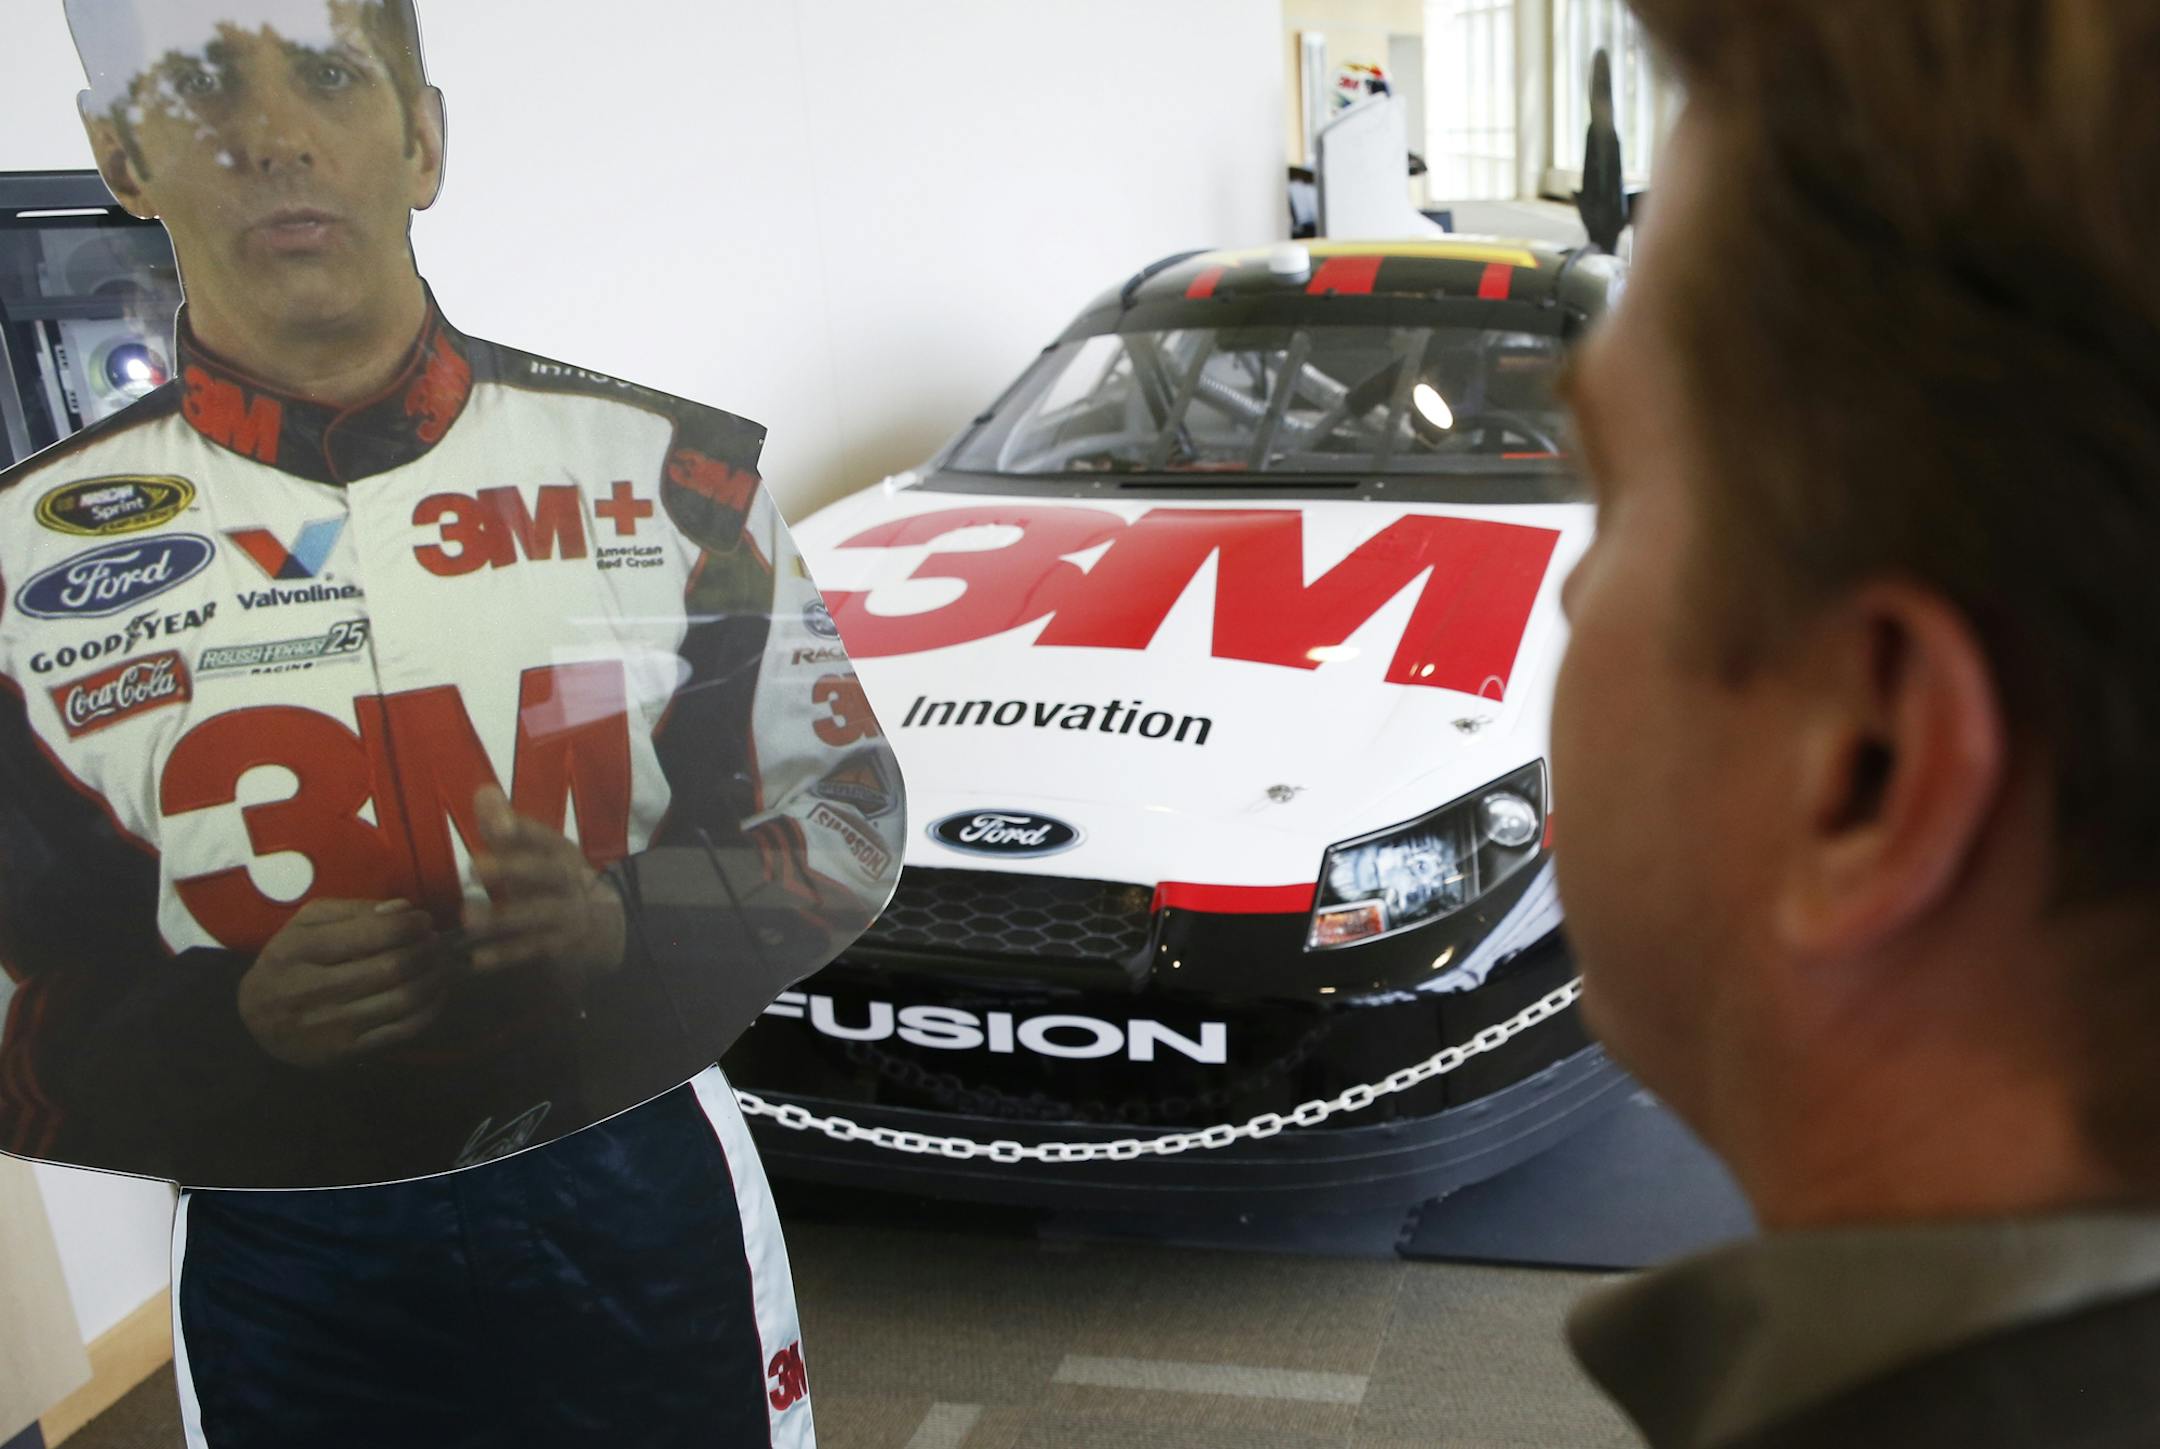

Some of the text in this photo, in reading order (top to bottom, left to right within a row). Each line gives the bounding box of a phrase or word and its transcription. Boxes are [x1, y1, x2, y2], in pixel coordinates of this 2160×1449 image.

[183, 366, 282, 464] 3M
[91, 497, 145, 521] Sprint
[412, 485, 588, 577] 3M
[596, 545, 663, 559] American
[60, 548, 172, 608] Ford
[596, 556, 664, 571] Red Cross
[236, 583, 357, 611] Valvoline
[823, 506, 1562, 704] 3M
[324, 621, 367, 654] 25
[901, 695, 1213, 746] Innovation
[160, 661, 633, 950] 3M
[959, 812, 1052, 847] Ford
